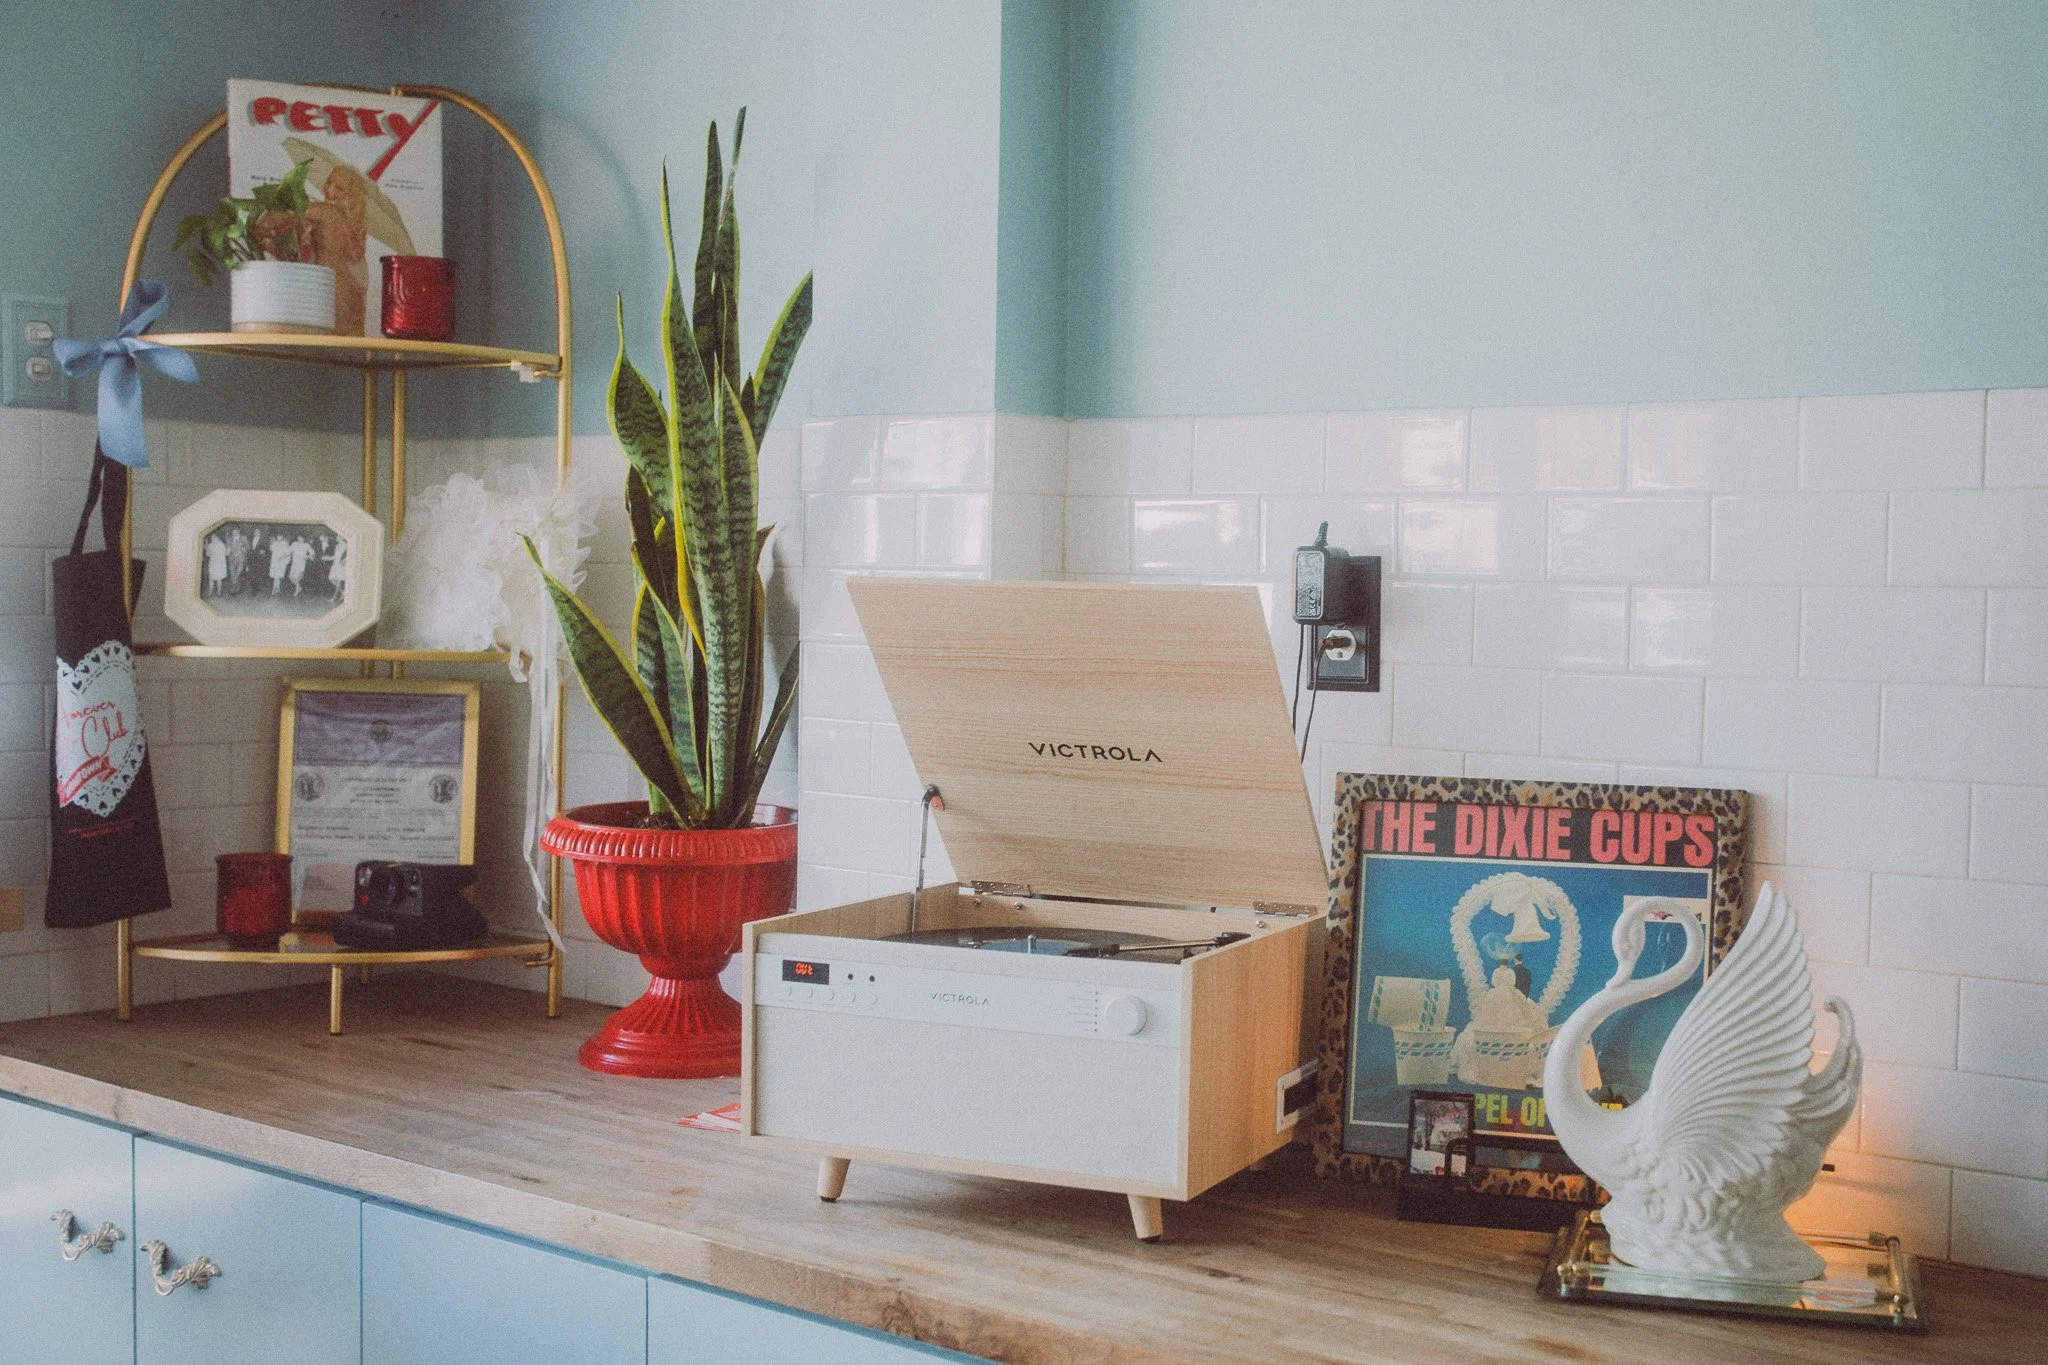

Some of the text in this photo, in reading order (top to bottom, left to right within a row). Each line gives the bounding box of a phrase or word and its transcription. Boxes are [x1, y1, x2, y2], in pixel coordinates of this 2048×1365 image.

[250, 96, 440, 181] PETTY
[82, 709, 128, 758] Club
[1028, 742, 1163, 763] VICTROLA
[1362, 801, 1716, 868] THE DIXIE CUPS
[930, 991, 991, 1006] VICTROLA
[1474, 1093, 1513, 1125] PEL
